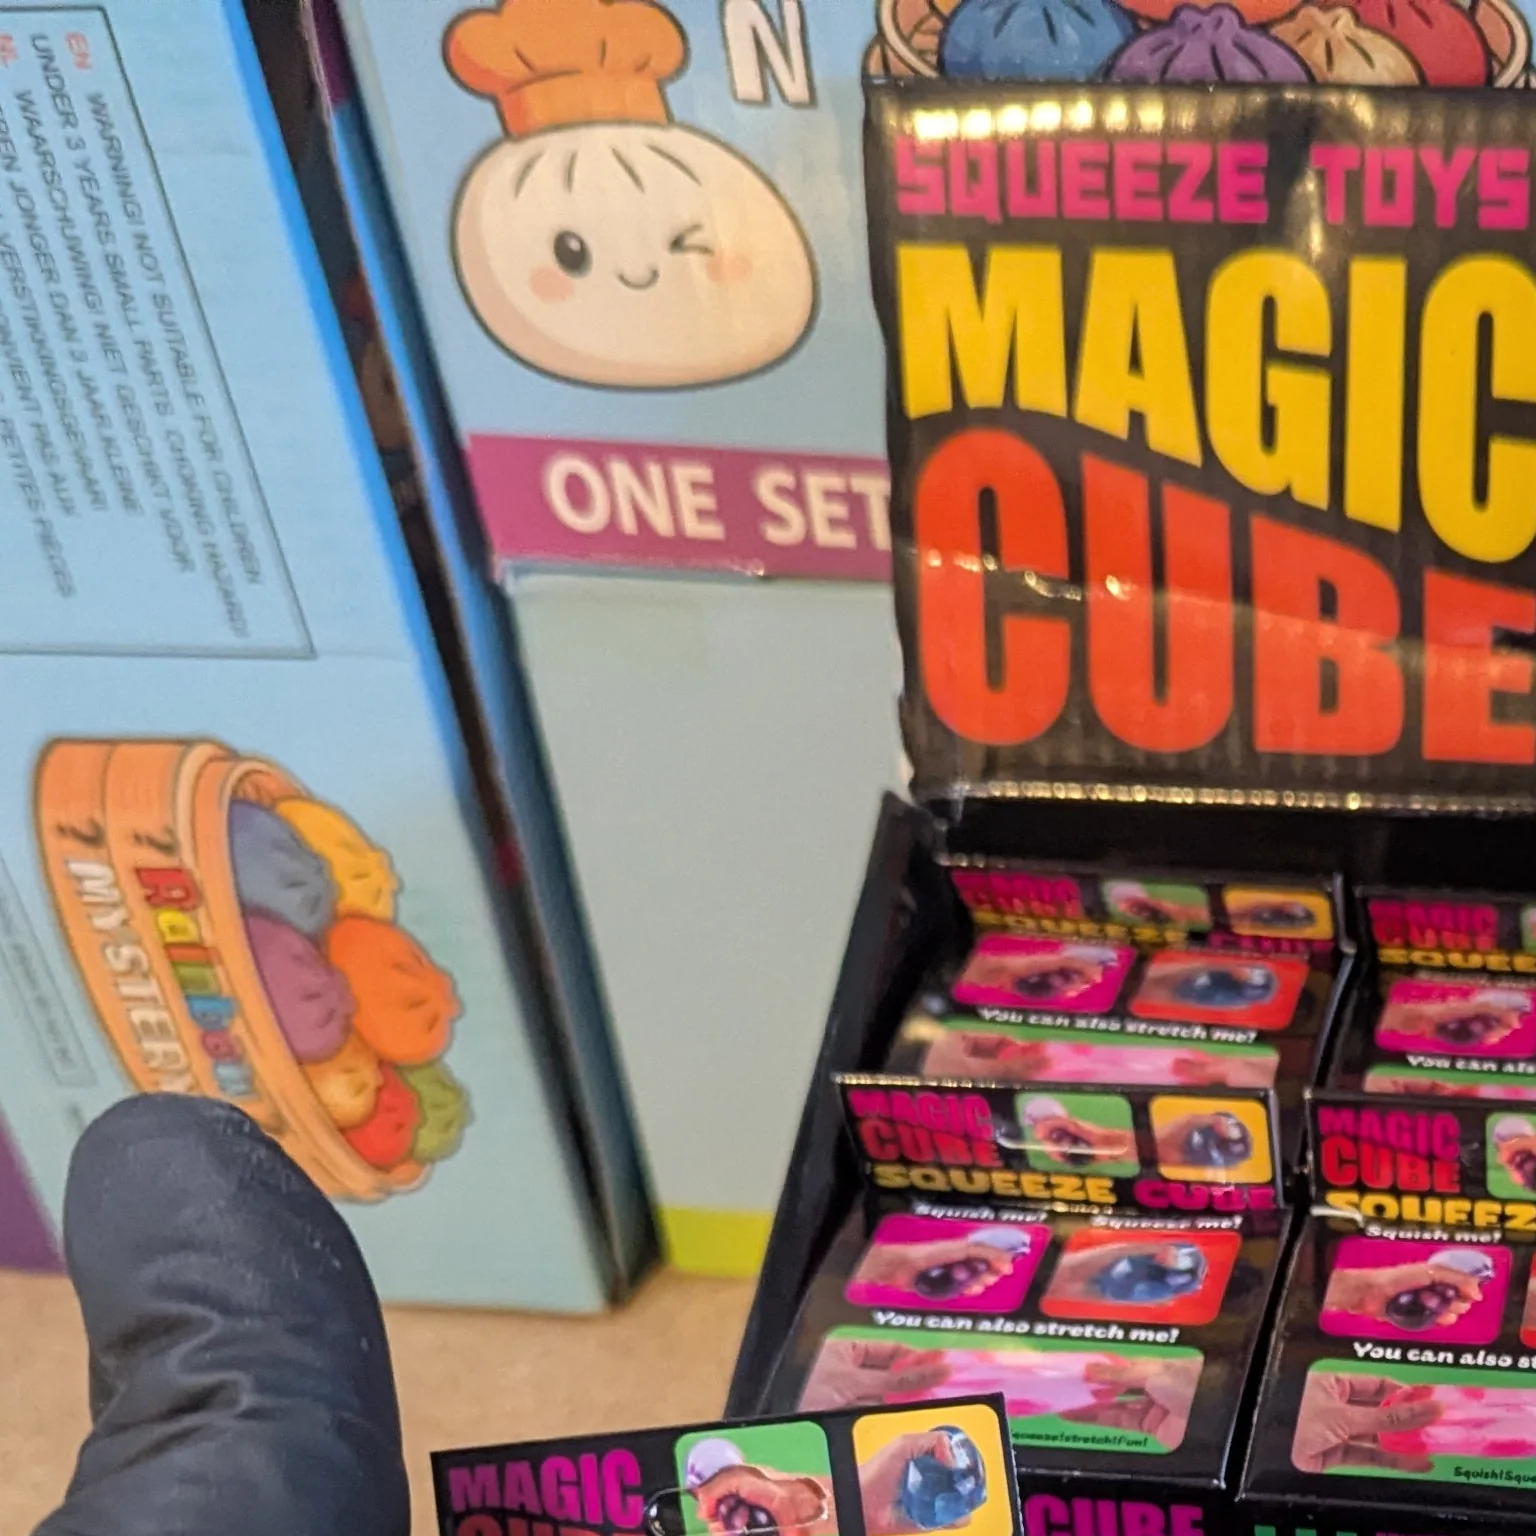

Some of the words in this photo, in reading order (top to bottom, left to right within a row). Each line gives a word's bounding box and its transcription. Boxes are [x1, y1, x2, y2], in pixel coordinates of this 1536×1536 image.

[31, 34, 78, 128] UNDER
[896, 137, 1269, 225] SQUEEZE
[1312, 145, 1531, 231] TOYS
[132, 231, 165, 283] NOT
[152, 293, 204, 405] SUITABLE
[544, 454, 725, 542] ONE
[752, 467, 892, 553] SET
[847, 1089, 994, 1140] MAGIC
[1317, 1106, 1462, 1162] MAGIC
[873, 1163, 1118, 1204] SQUEEZE
[1133, 1179, 1277, 1212] CUBE
[1320, 1136, 1463, 1194] CUBE
[871, 1309, 922, 1329] You
[924, 1313, 973, 1331] can
[977, 1315, 1031, 1335] also
[1033, 1319, 1125, 1342] stretch
[1129, 1326, 1180, 1344] me!
[1353, 1342, 1401, 1361] You
[1407, 1348, 1454, 1363] can
[1460, 1351, 1513, 1368] also
[447, 1448, 645, 1530] MAGIC
